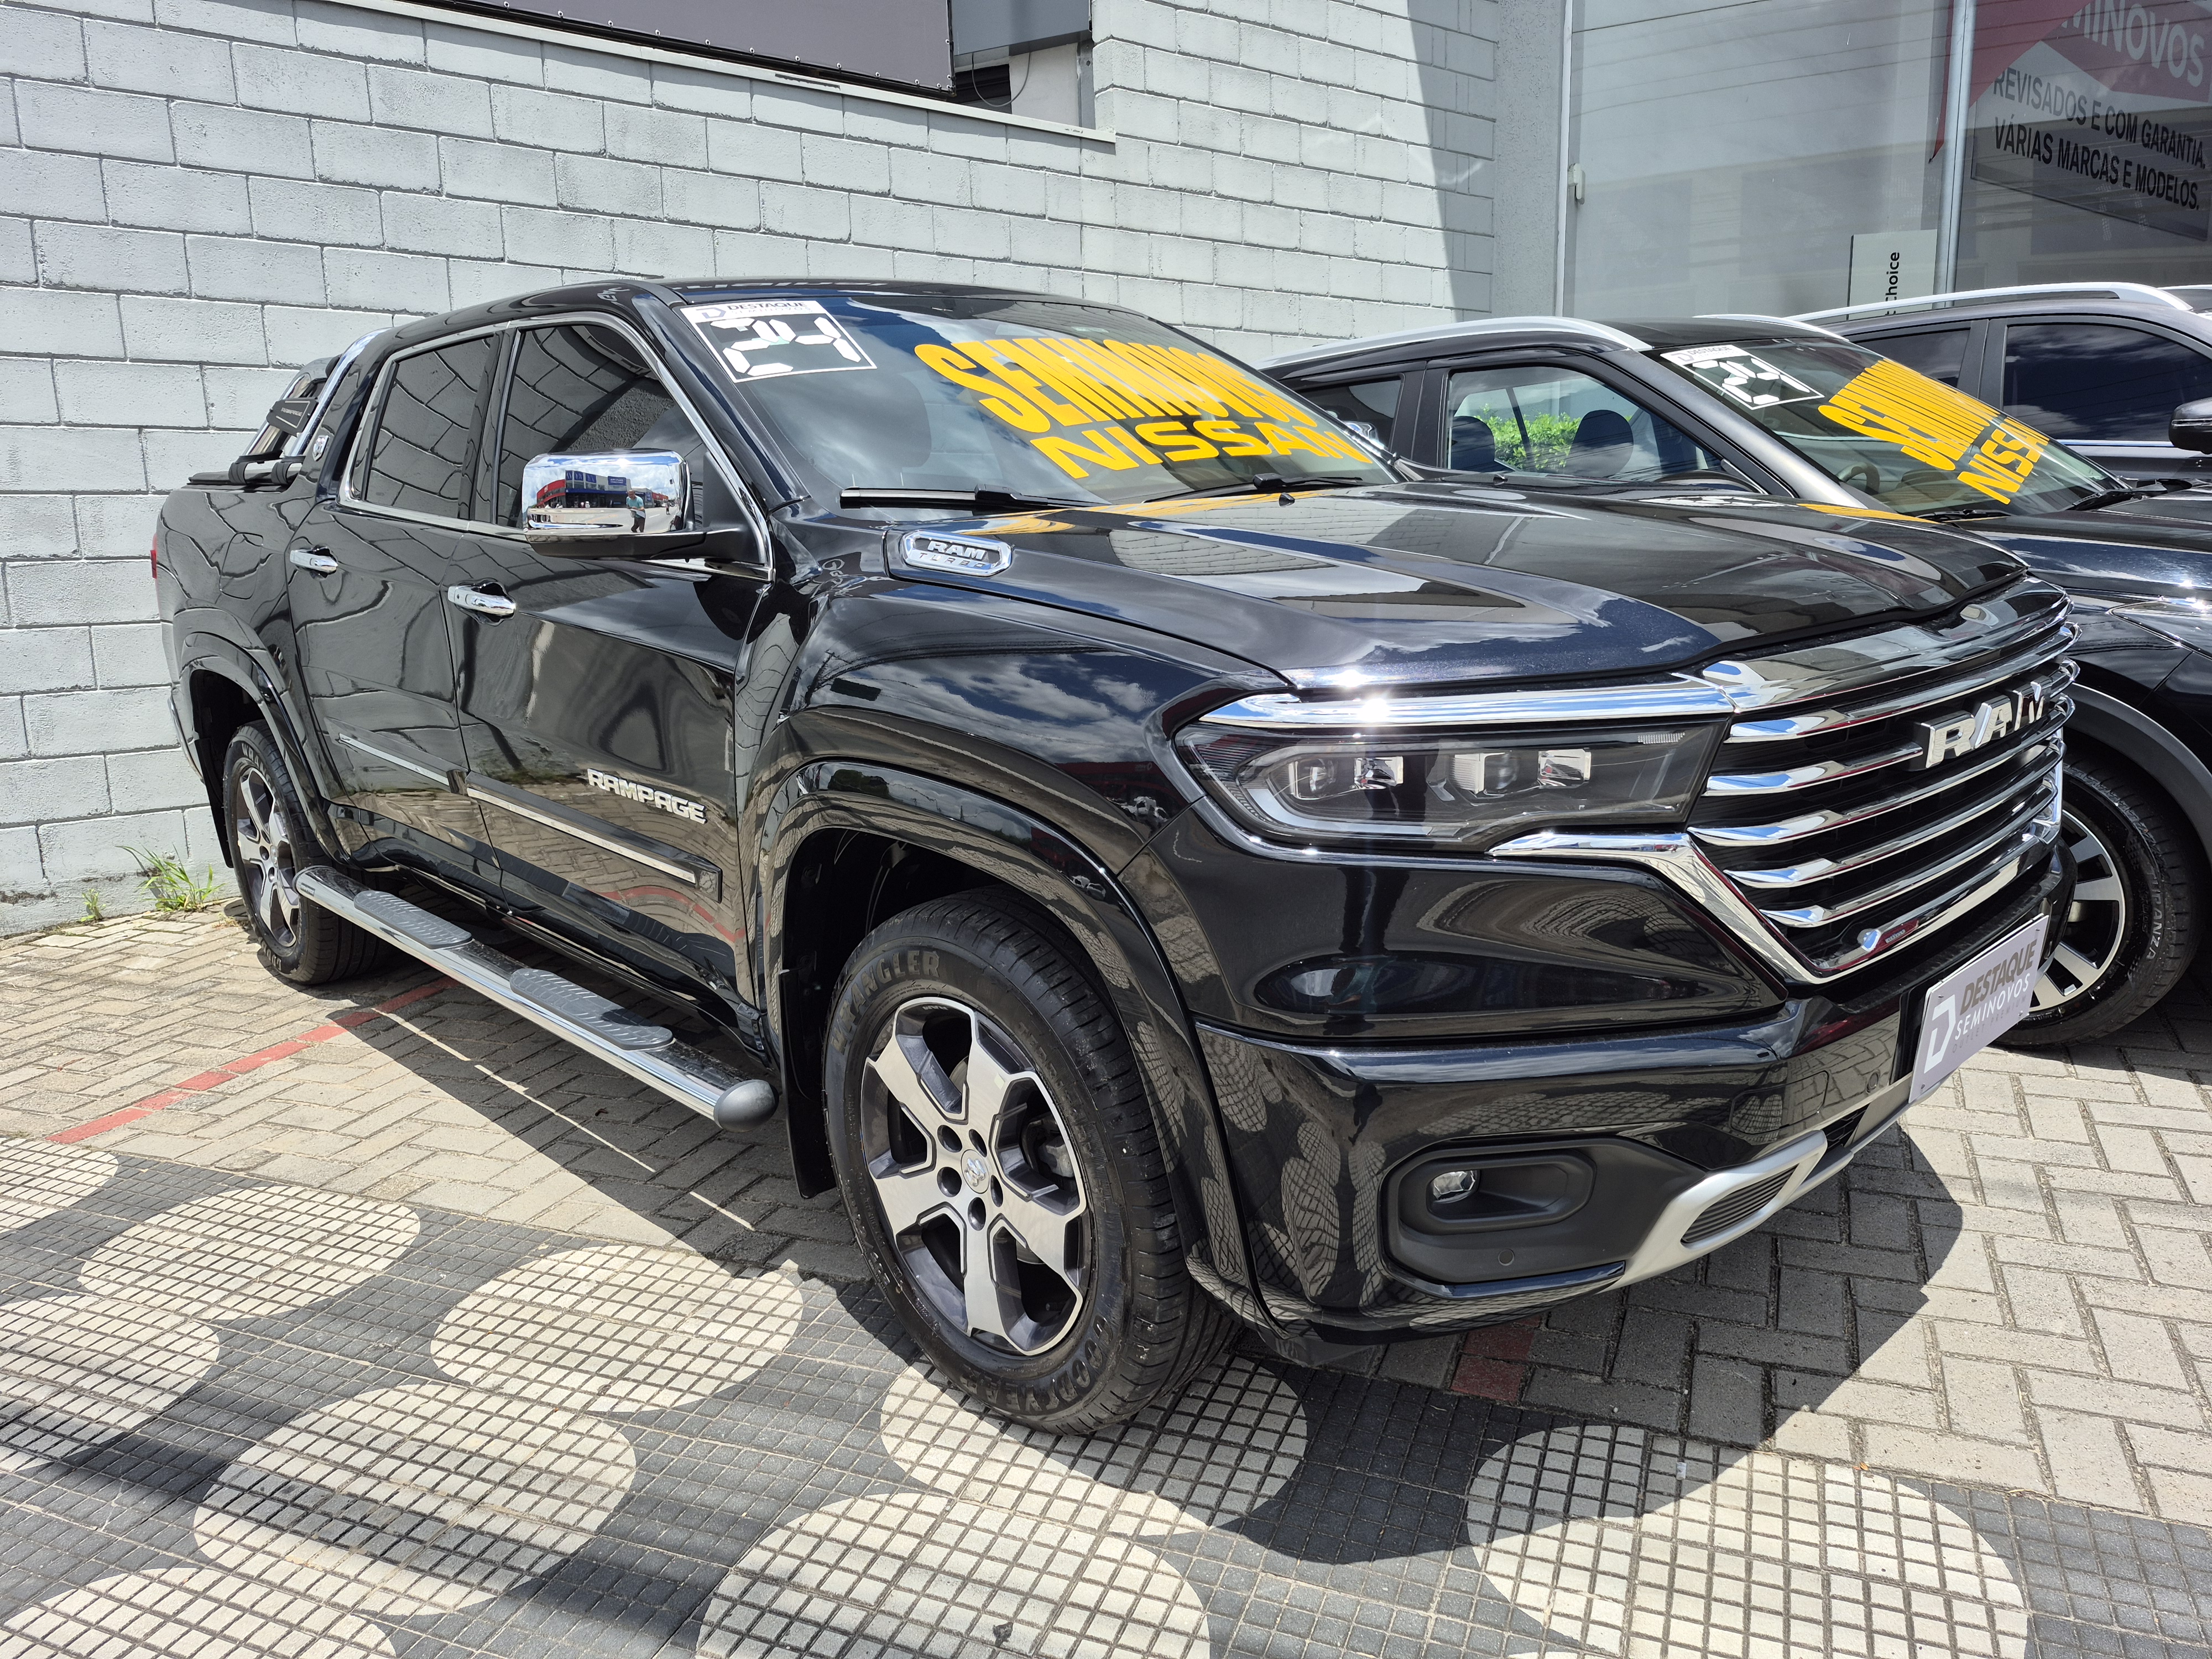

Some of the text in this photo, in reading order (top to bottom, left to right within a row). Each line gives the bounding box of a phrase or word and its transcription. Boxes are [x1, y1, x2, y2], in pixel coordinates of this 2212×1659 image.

[1994, 67, 2087, 126] REVISADOS
[2091, 100, 2102, 131] E
[2105, 105, 2138, 143] COM
[1995, 114, 2200, 211] VÁRIAS MARCAS E MODELOS.
[727, 302, 808, 311] DESTAQUE
[710, 317, 862, 377] 24
[914, 337, 1317, 433] SEMINOVOS
[1692, 358, 1810, 405] 24
[1030, 420, 1373, 479] NISSAN
[919, 552, 986, 568] TURBO
[927, 540, 987, 561] RAM
[1924, 681, 2047, 769] RAM
[587, 768, 707, 825] RAMPAGE
[831, 950, 940, 1055] WRANGLER
[1954, 973, 2031, 1040] SEMINOVOS
[1960, 939, 2037, 1015] DESTAQUE
